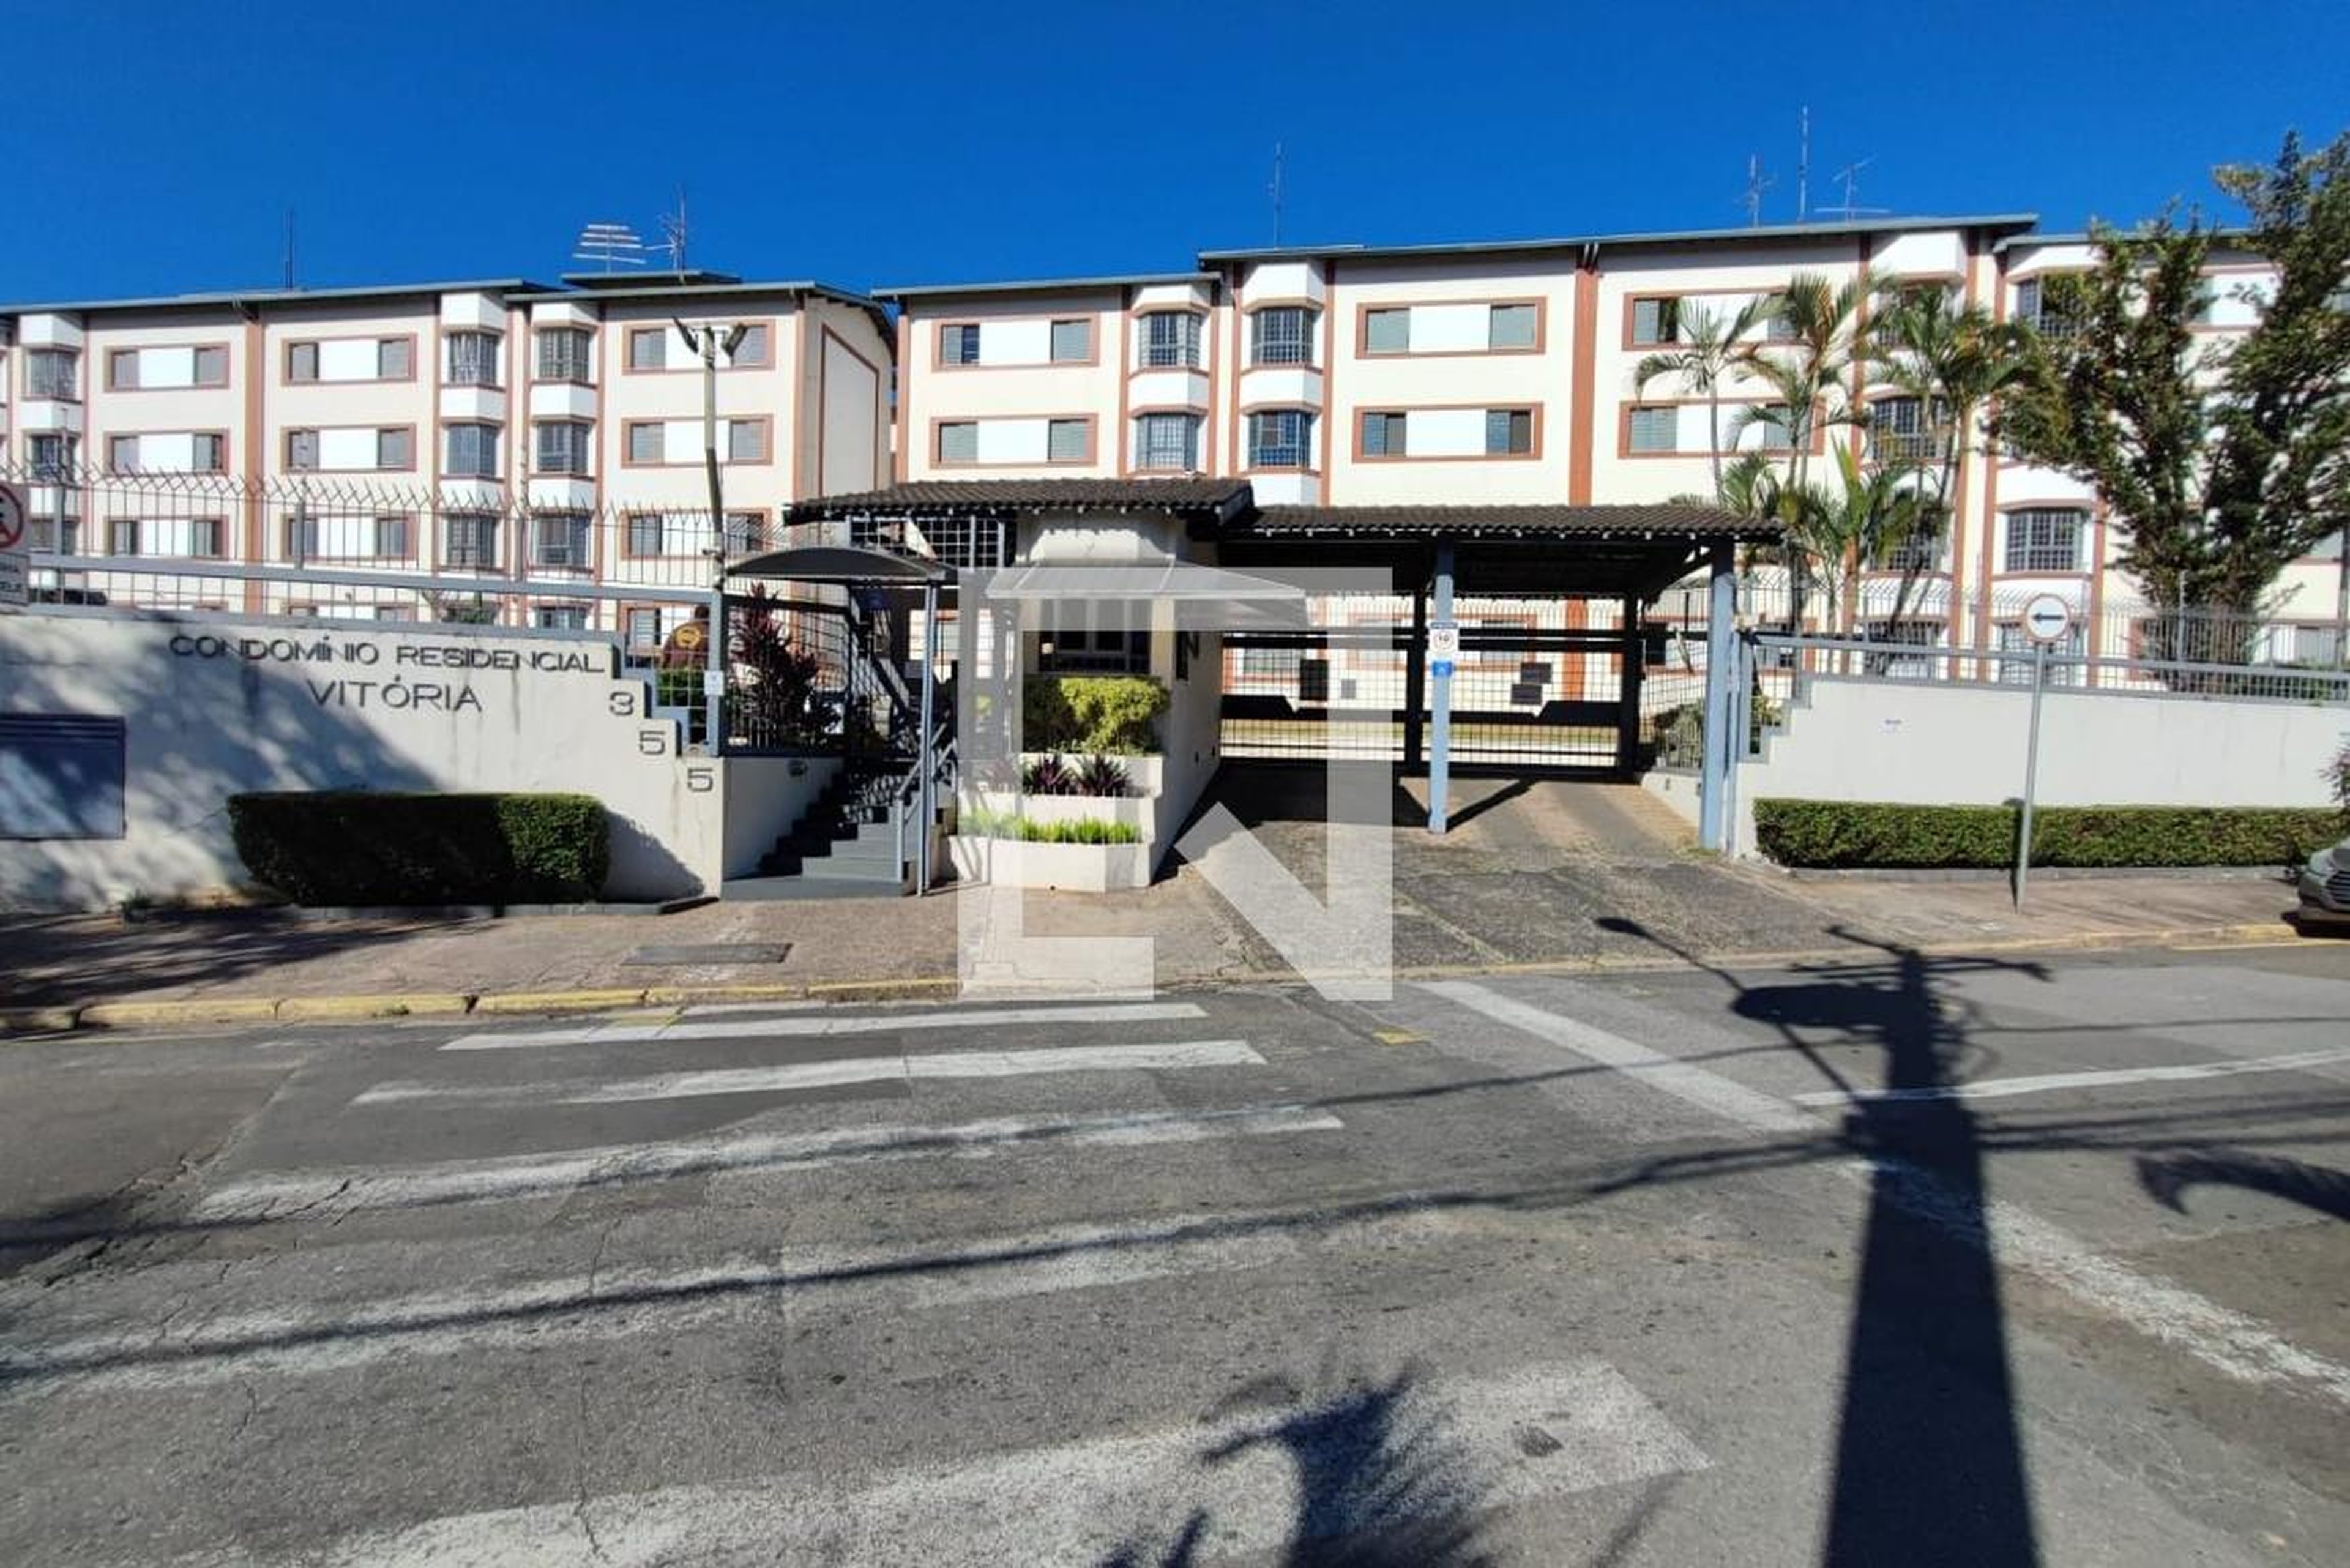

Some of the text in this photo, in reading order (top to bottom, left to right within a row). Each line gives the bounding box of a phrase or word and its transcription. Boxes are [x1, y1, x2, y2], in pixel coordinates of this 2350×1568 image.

[170, 635, 605, 673] CONDOMÍNIO RESIDENCIAL
[307, 674, 482, 712] VITÓRIA
[610, 691, 635, 717] 3
[639, 730, 666, 756] 5
[686, 767, 714, 793] 5
